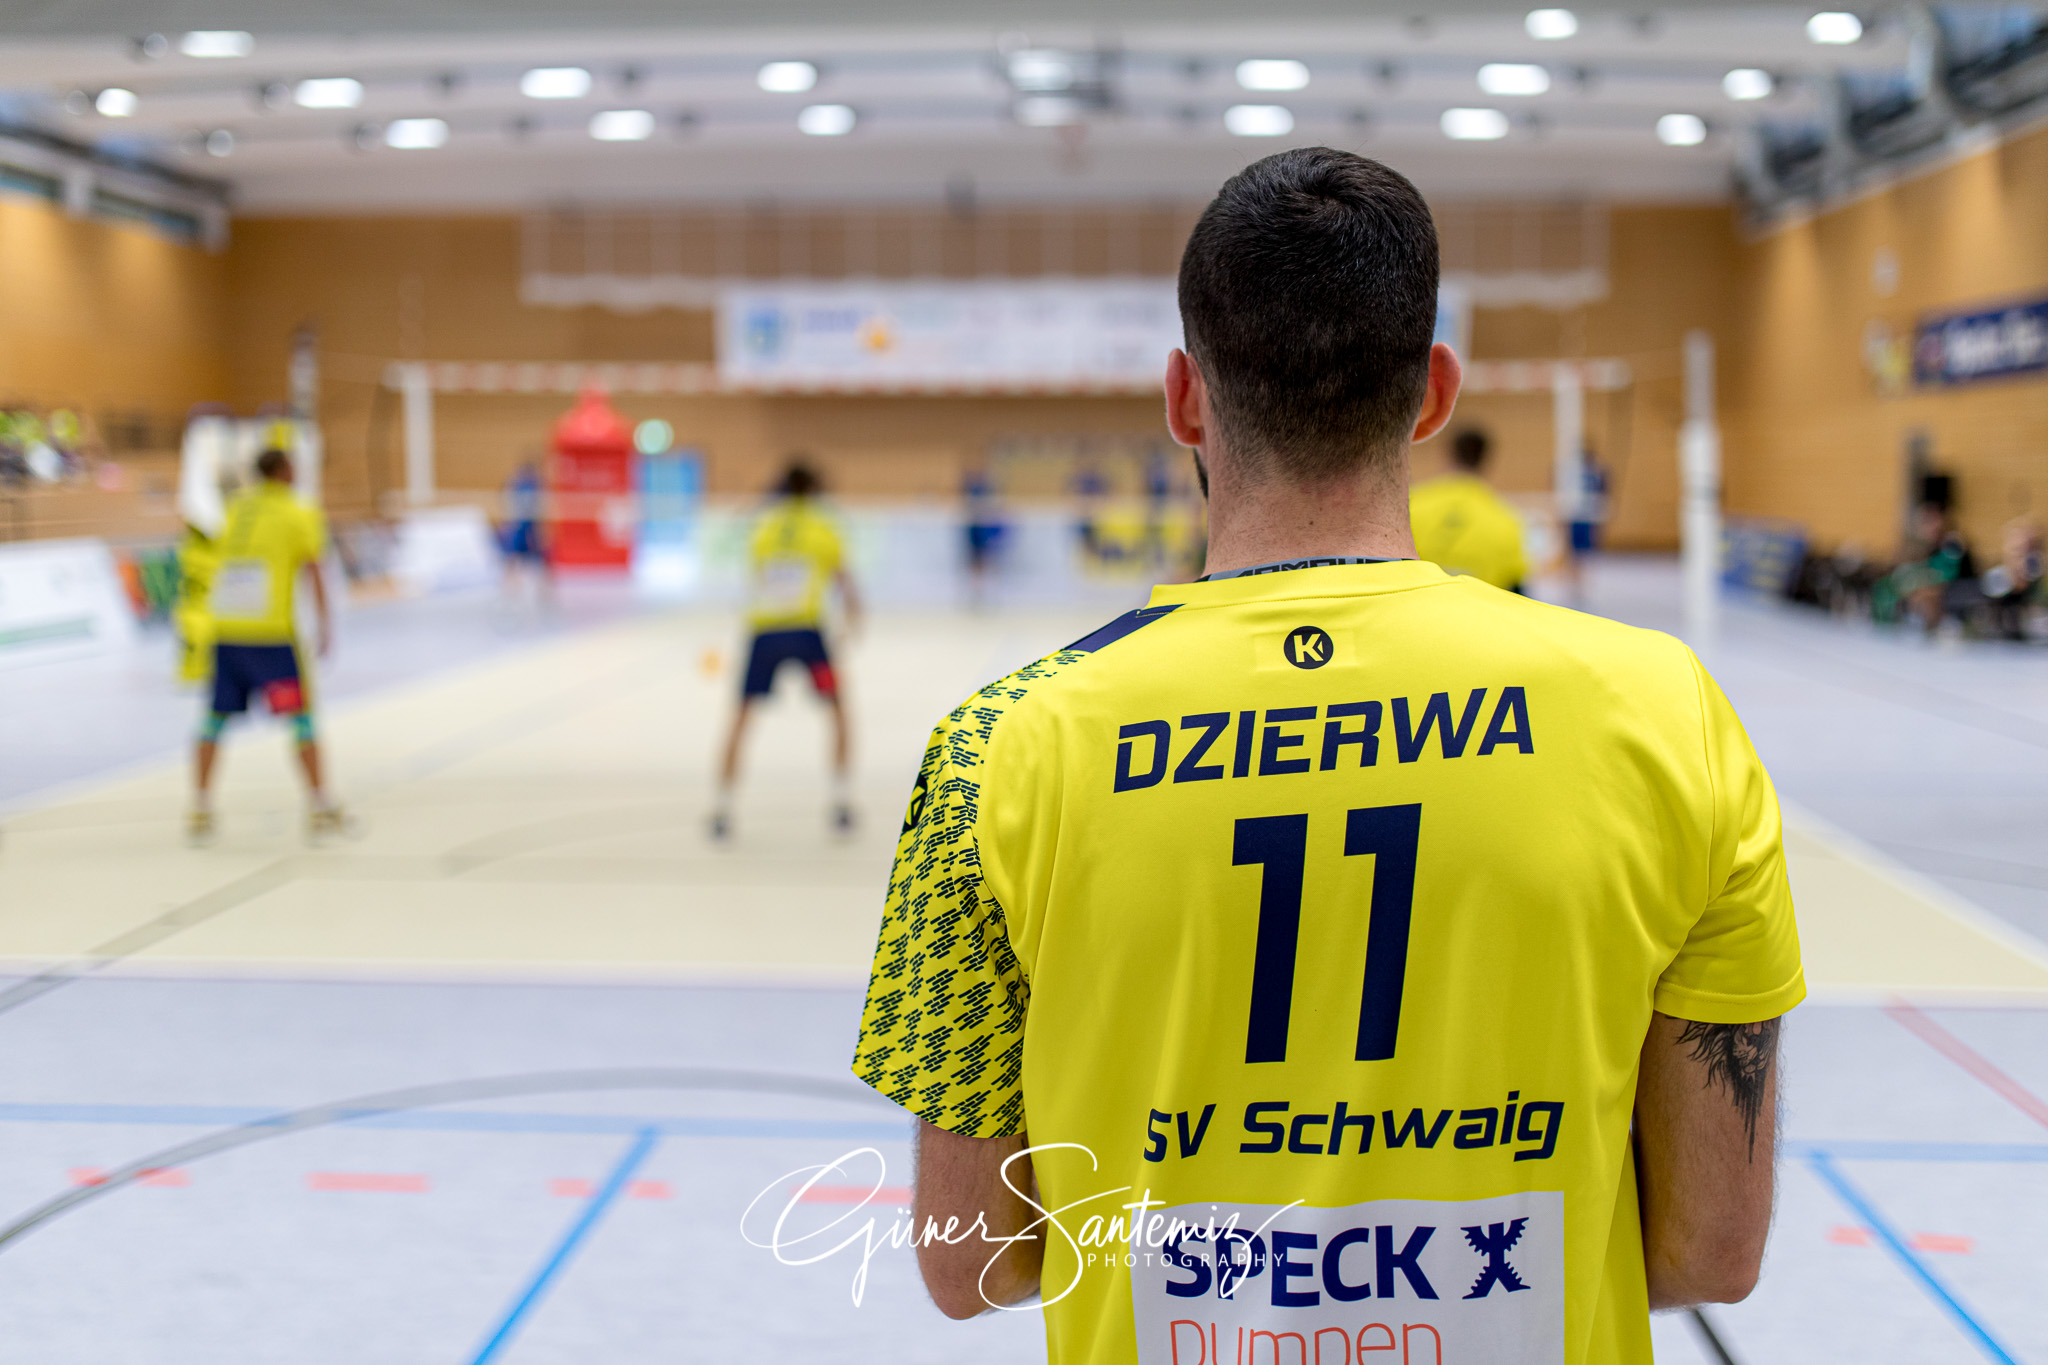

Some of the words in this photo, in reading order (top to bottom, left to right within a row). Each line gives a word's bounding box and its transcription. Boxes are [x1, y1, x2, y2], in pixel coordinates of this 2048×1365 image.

[1113, 686, 1535, 794] DZIERWA
[1231, 802, 1423, 1064] 11
[1143, 1103, 1217, 1163] SV
[1239, 1090, 1566, 1163] Schwaig
[1162, 1224, 1440, 1308] SPECK
